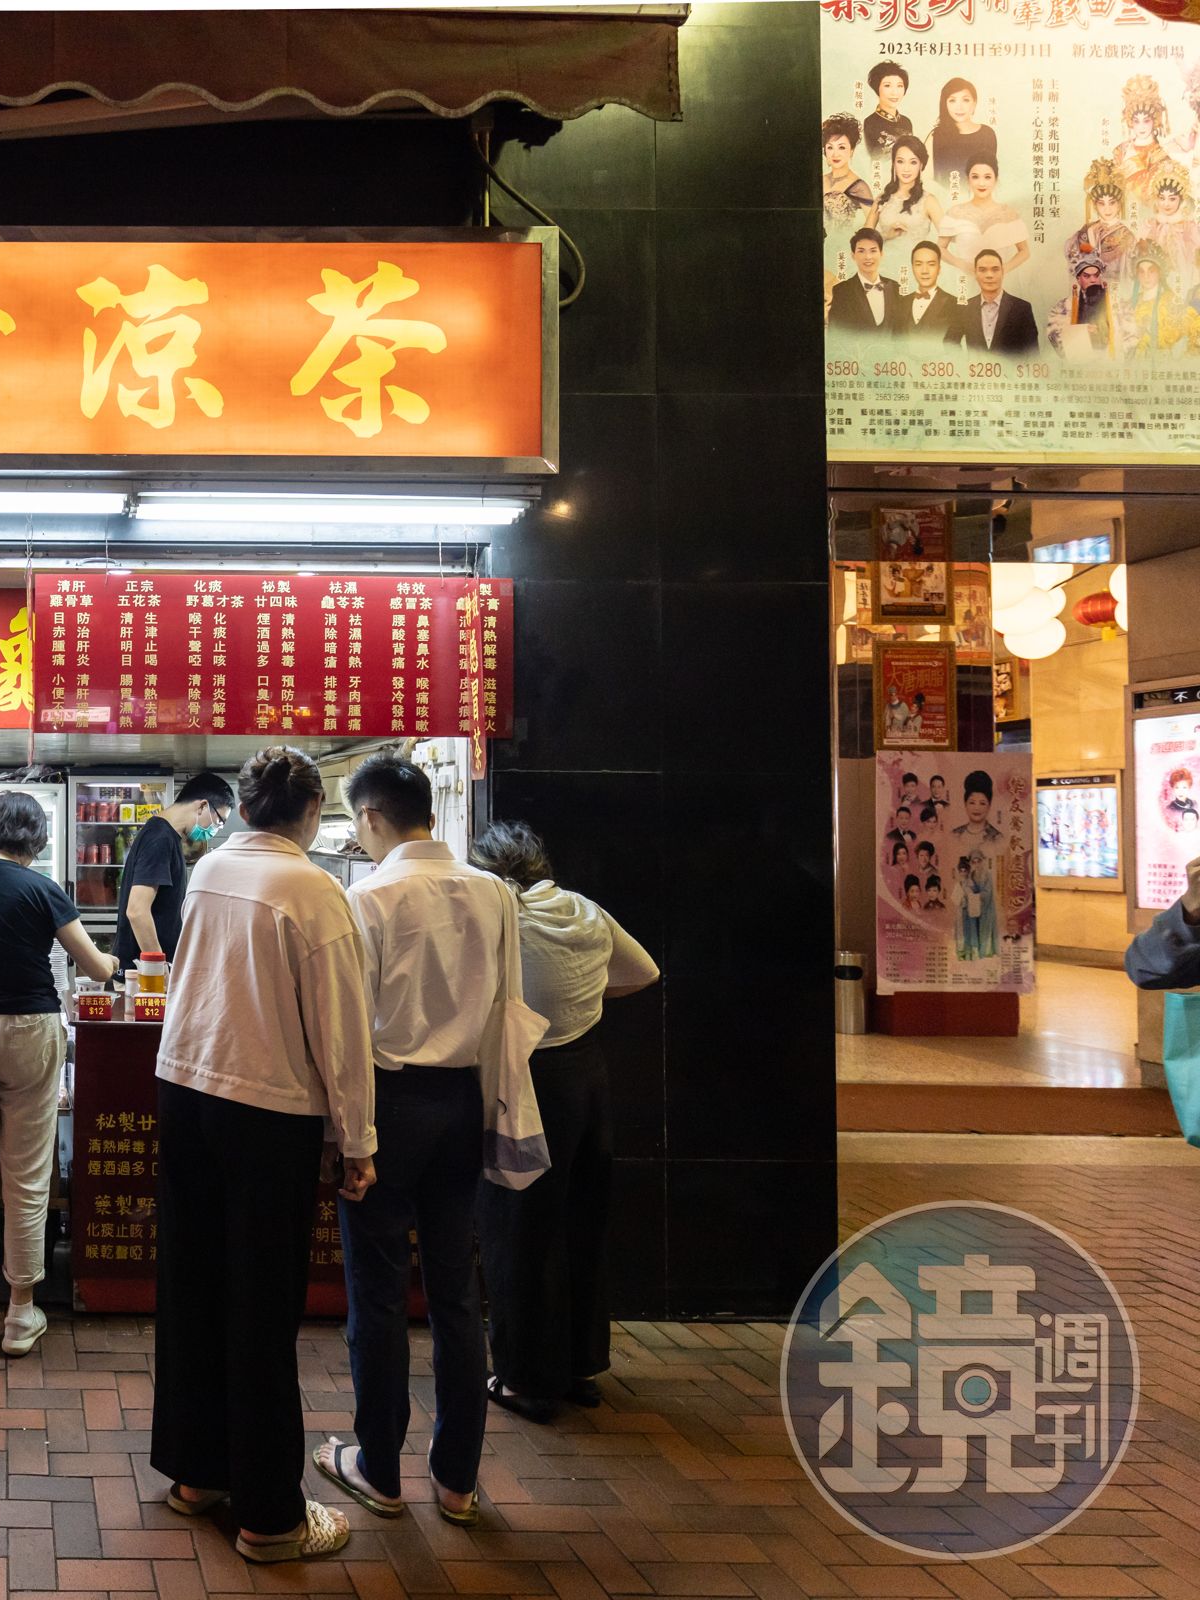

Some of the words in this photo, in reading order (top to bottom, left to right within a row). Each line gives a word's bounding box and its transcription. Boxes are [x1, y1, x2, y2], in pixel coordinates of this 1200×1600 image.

[879, 42, 1052, 58] 2023年8月31日至9月1日
[1072, 43, 1185, 60] 新光戲院大劇場
[1016, 364, 1049, 378] $180
[49, 594, 94, 608] 雞骨草
[57, 580, 86, 593] 清肝
[117, 595, 161, 607] 五花茶
[125, 580, 154, 592] 正宗
[194, 579, 222, 593] 化痰
[254, 595, 298, 608] 廿四味
[320, 596, 365, 610] 龜苓茶
[389, 597, 433, 610] 感冒茶
[396, 582, 426, 595] 特效
[51, 612, 66, 666] 目赤腫痛
[76, 612, 90, 666] 防治肝炎
[119, 612, 133, 666] 清肝明目
[188, 612, 202, 667] 喉干聲啞
[212, 612, 227, 667] 化痰止咳
[256, 613, 271, 667] 煙酒過多
[281, 613, 295, 668] 清熱解毒
[323, 613, 337, 669] 消除暗瘡
[391, 614, 406, 670] 腰酸背痛
[415, 614, 430, 670] 鼻塞鼻水
[483, 615, 497, 671] 清熱解毒
[144, 674, 158, 728] 清熱去濕
[188, 674, 202, 728] 清除骨火
[212, 674, 227, 729] 消炎解毒
[256, 676, 271, 730] 口臭口苦
[281, 674, 295, 730] 預防中暑
[323, 676, 337, 732] 排毒養顏
[348, 676, 362, 732] 牙肉腫痛
[391, 676, 406, 732] 發冷發熱
[415, 677, 430, 732] 喉痛咳嗽
[88, 1007, 104, 1016] $12
[144, 1008, 160, 1017] $12
[87, 1160, 145, 1177] 煙酒過多
[88, 1138, 145, 1154] 清熱解毒
[311, 1227, 343, 1244] 明目
[319, 1201, 337, 1222] 茶
